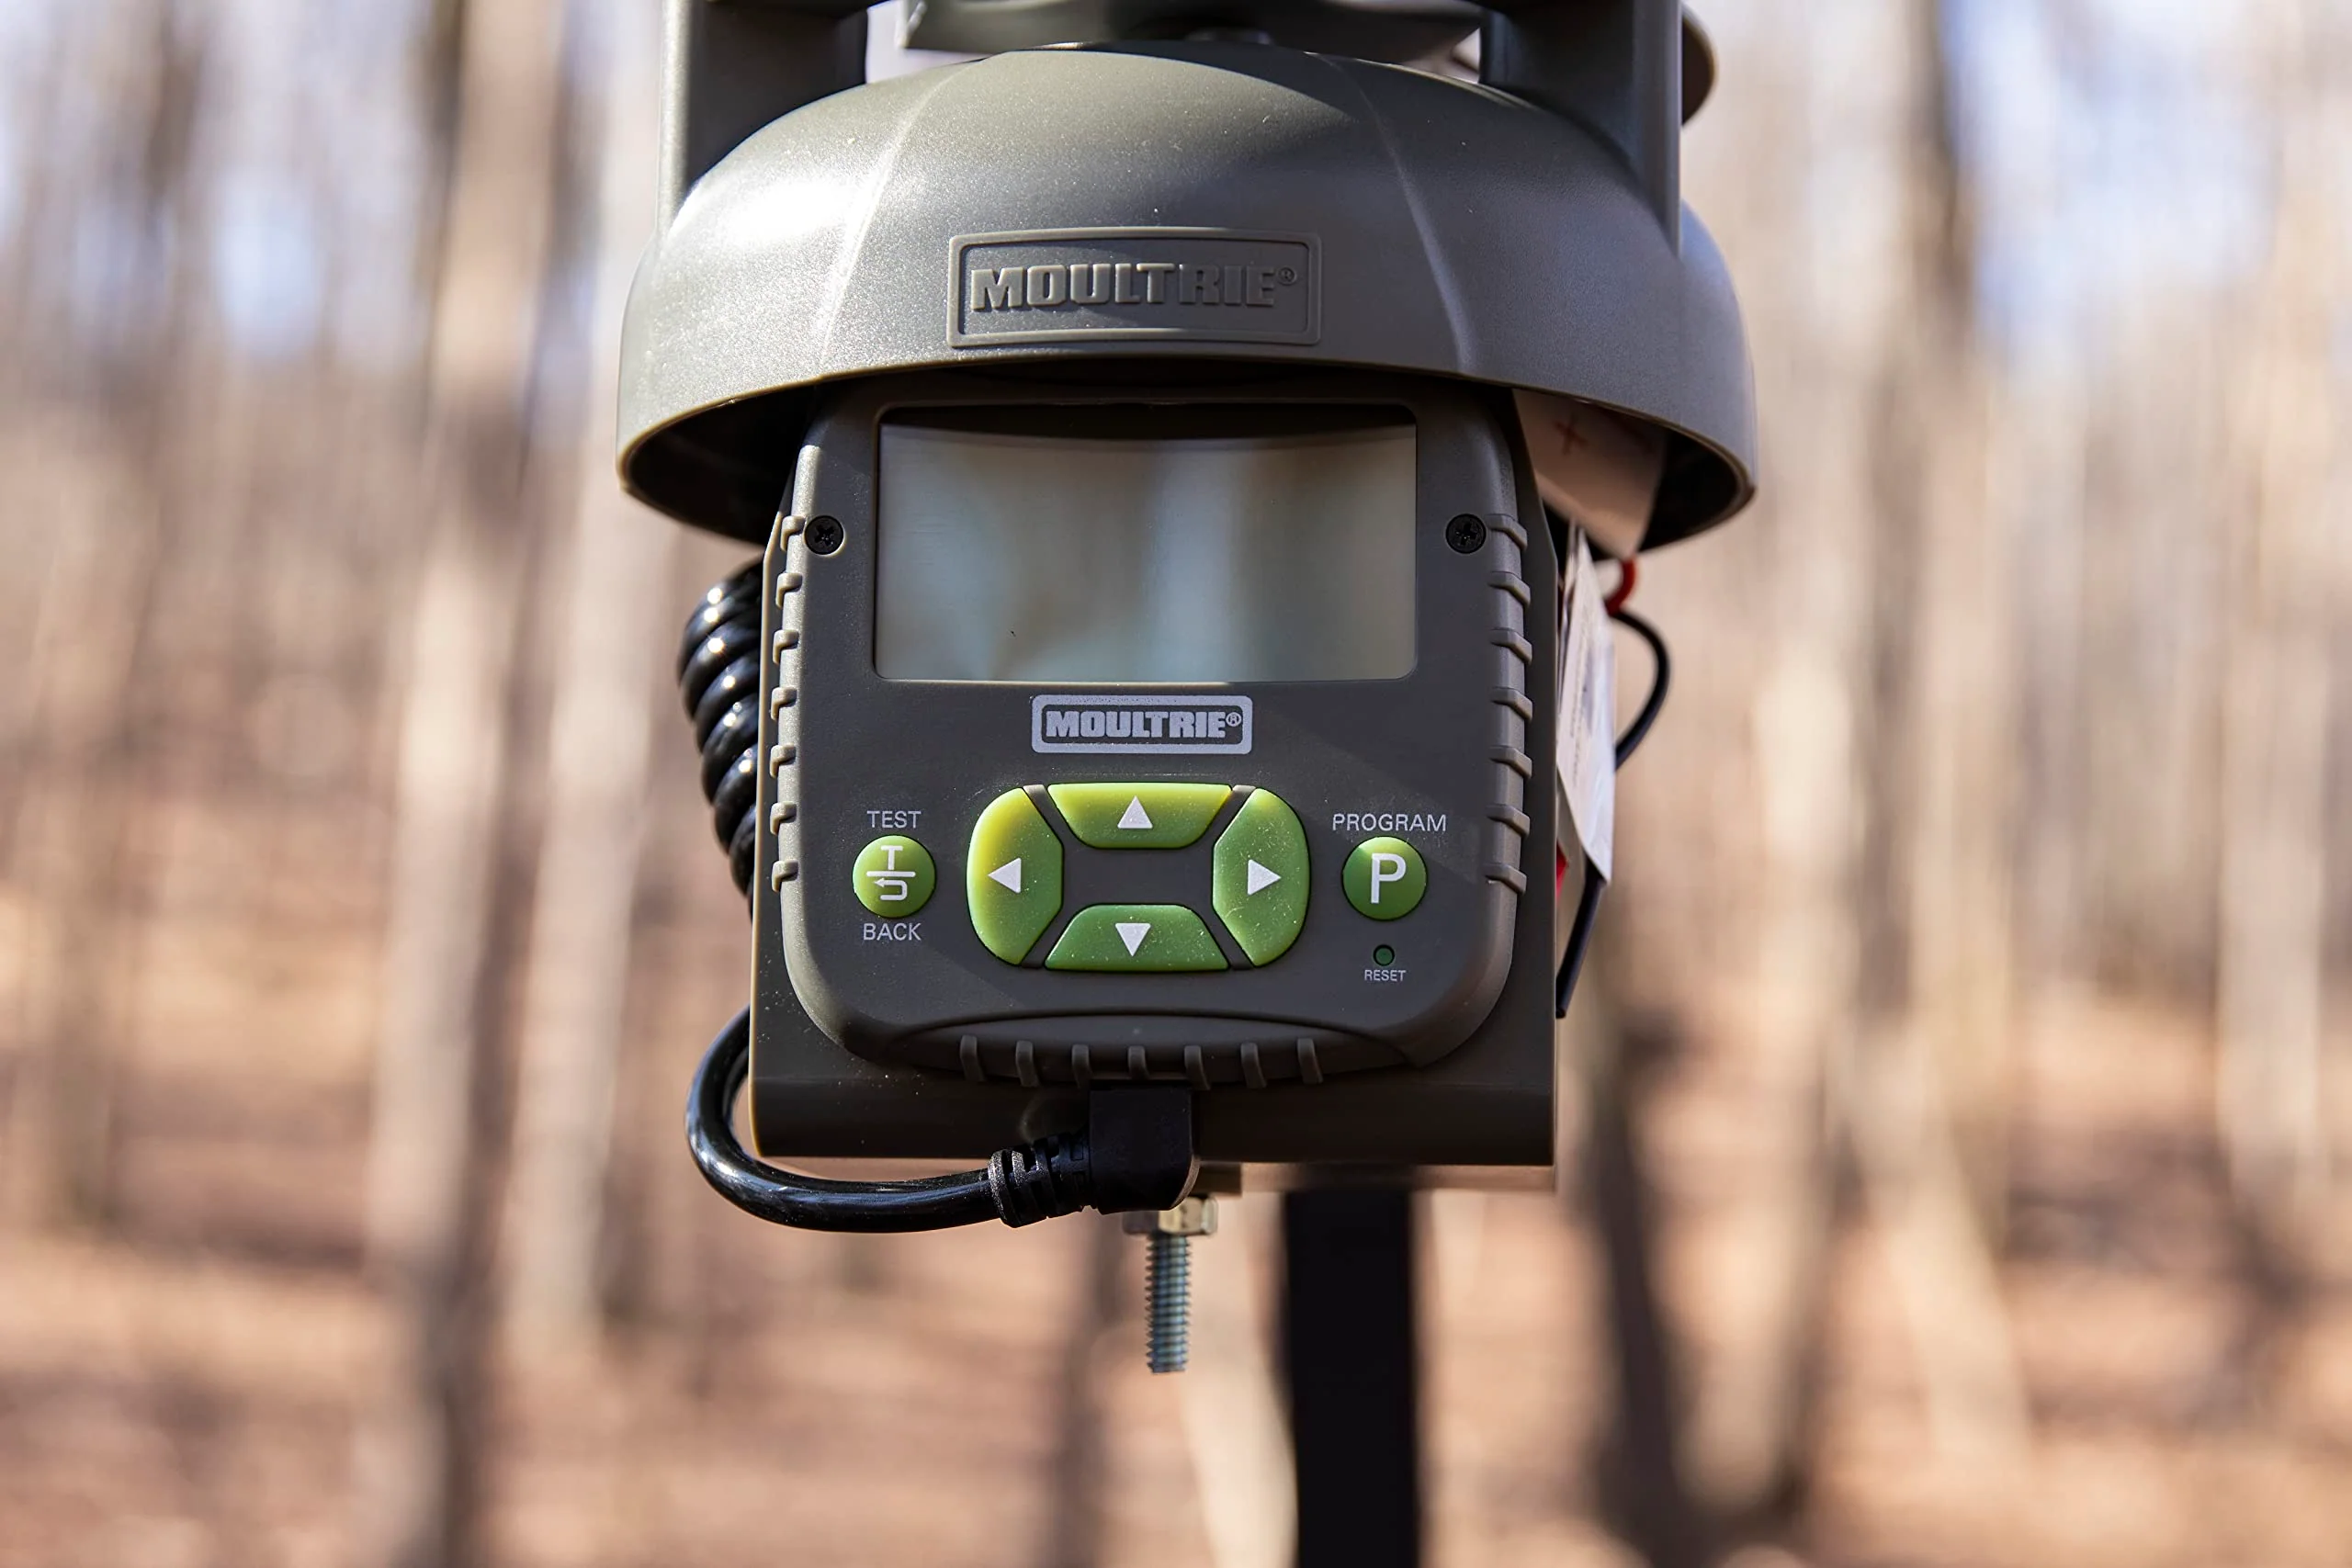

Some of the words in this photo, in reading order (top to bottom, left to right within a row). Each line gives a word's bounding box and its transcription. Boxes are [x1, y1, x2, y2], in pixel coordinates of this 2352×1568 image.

[866, 810, 922, 829] TEST
[1332, 813, 1447, 831] PROGRAM
[1371, 852, 1407, 904] P
[863, 922, 922, 941] BACK
[1364, 969, 1407, 982] RESET
